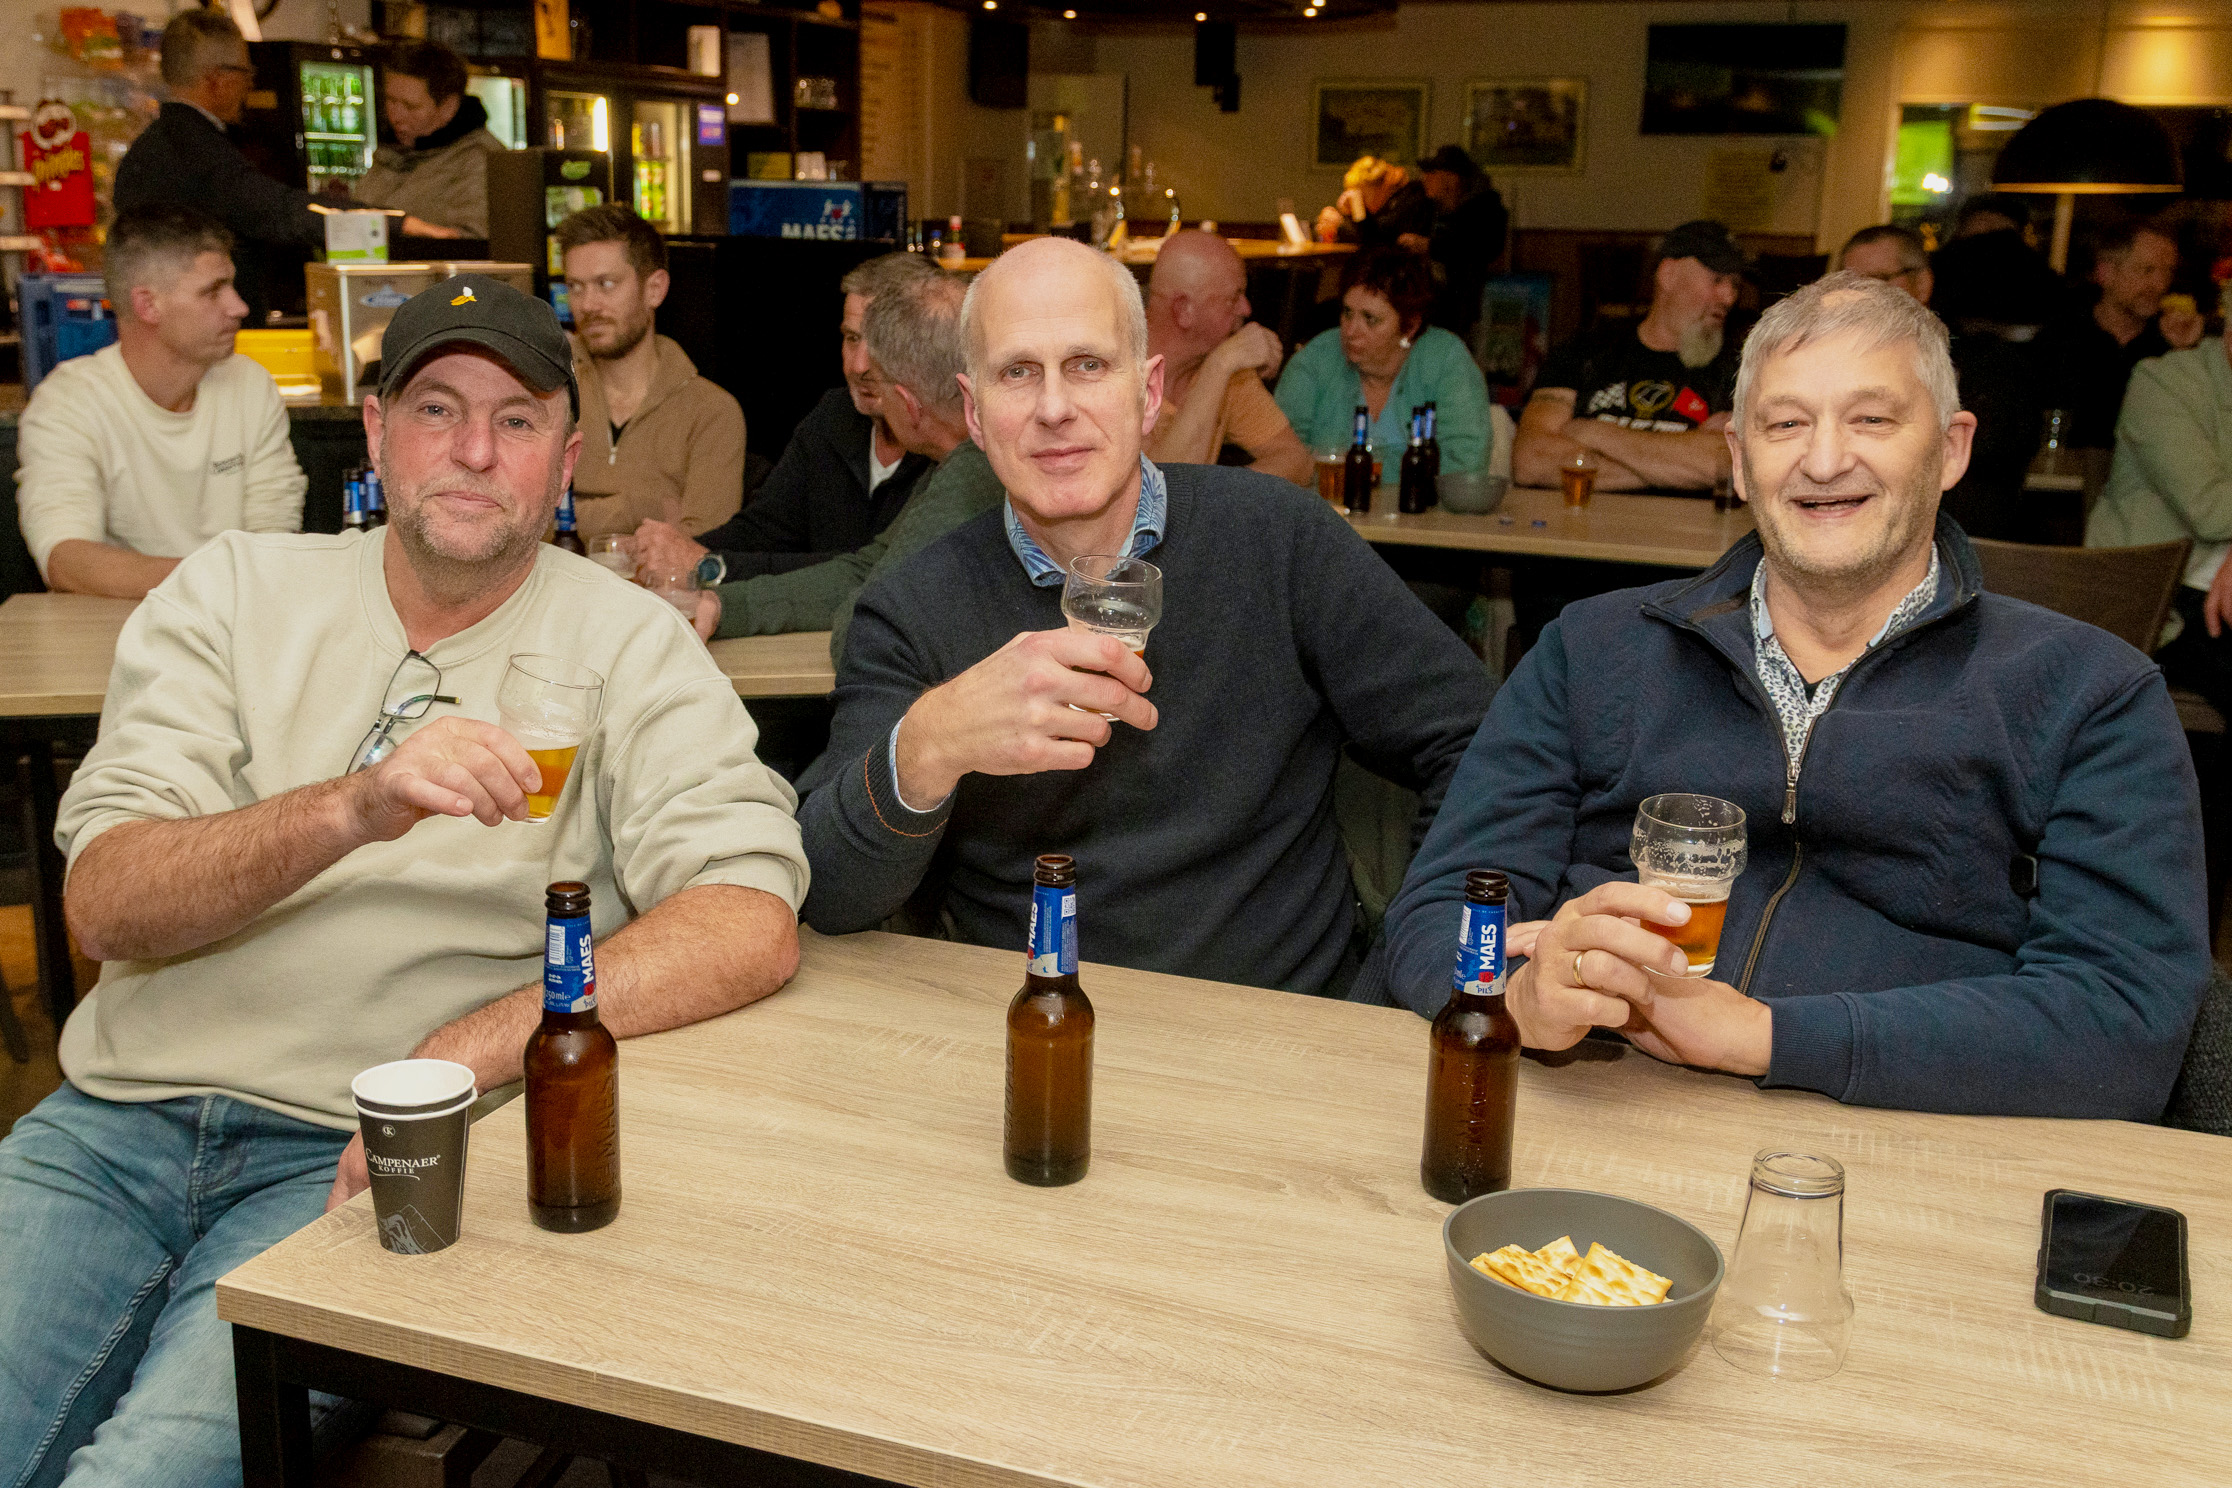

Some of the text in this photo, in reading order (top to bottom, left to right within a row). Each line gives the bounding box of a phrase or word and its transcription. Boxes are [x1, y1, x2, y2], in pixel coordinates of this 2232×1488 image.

[1028, 902, 1039, 948] MAES
[1479, 923, 1498, 970] MAES
[579, 933, 595, 984] MAES
[365, 1147, 439, 1169] CAMPENAER
[378, 1164, 415, 1174] KOFFIE
